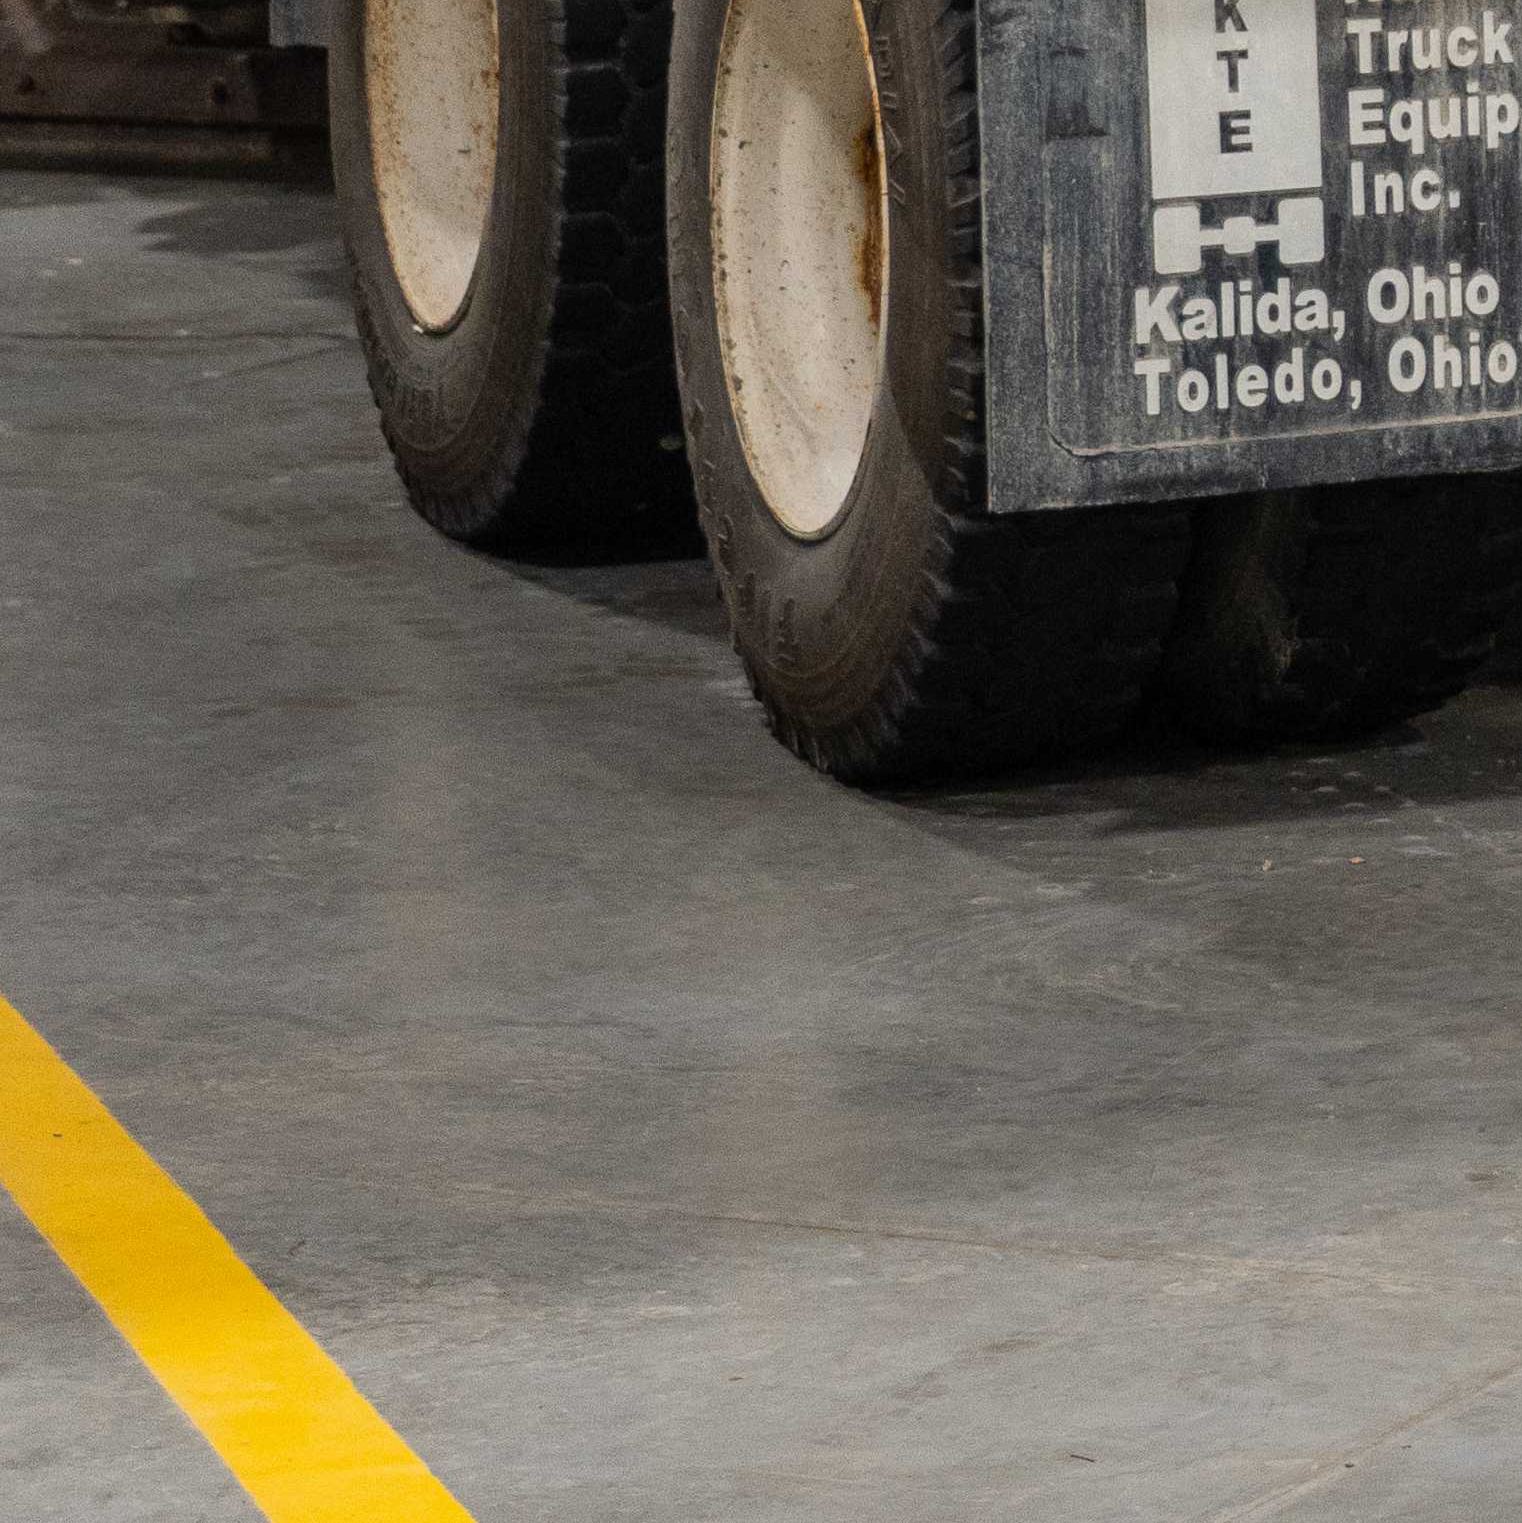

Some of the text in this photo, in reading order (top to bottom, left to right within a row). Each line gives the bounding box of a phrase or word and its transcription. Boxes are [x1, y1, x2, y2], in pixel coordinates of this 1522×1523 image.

[1346, 10, 1516, 74] Truck
[1350, 160, 1462, 216] Inc.
[1134, 262, 1500, 345] Kalida, Ohio
[1133, 331, 1518, 416] Toledo, Ohio
